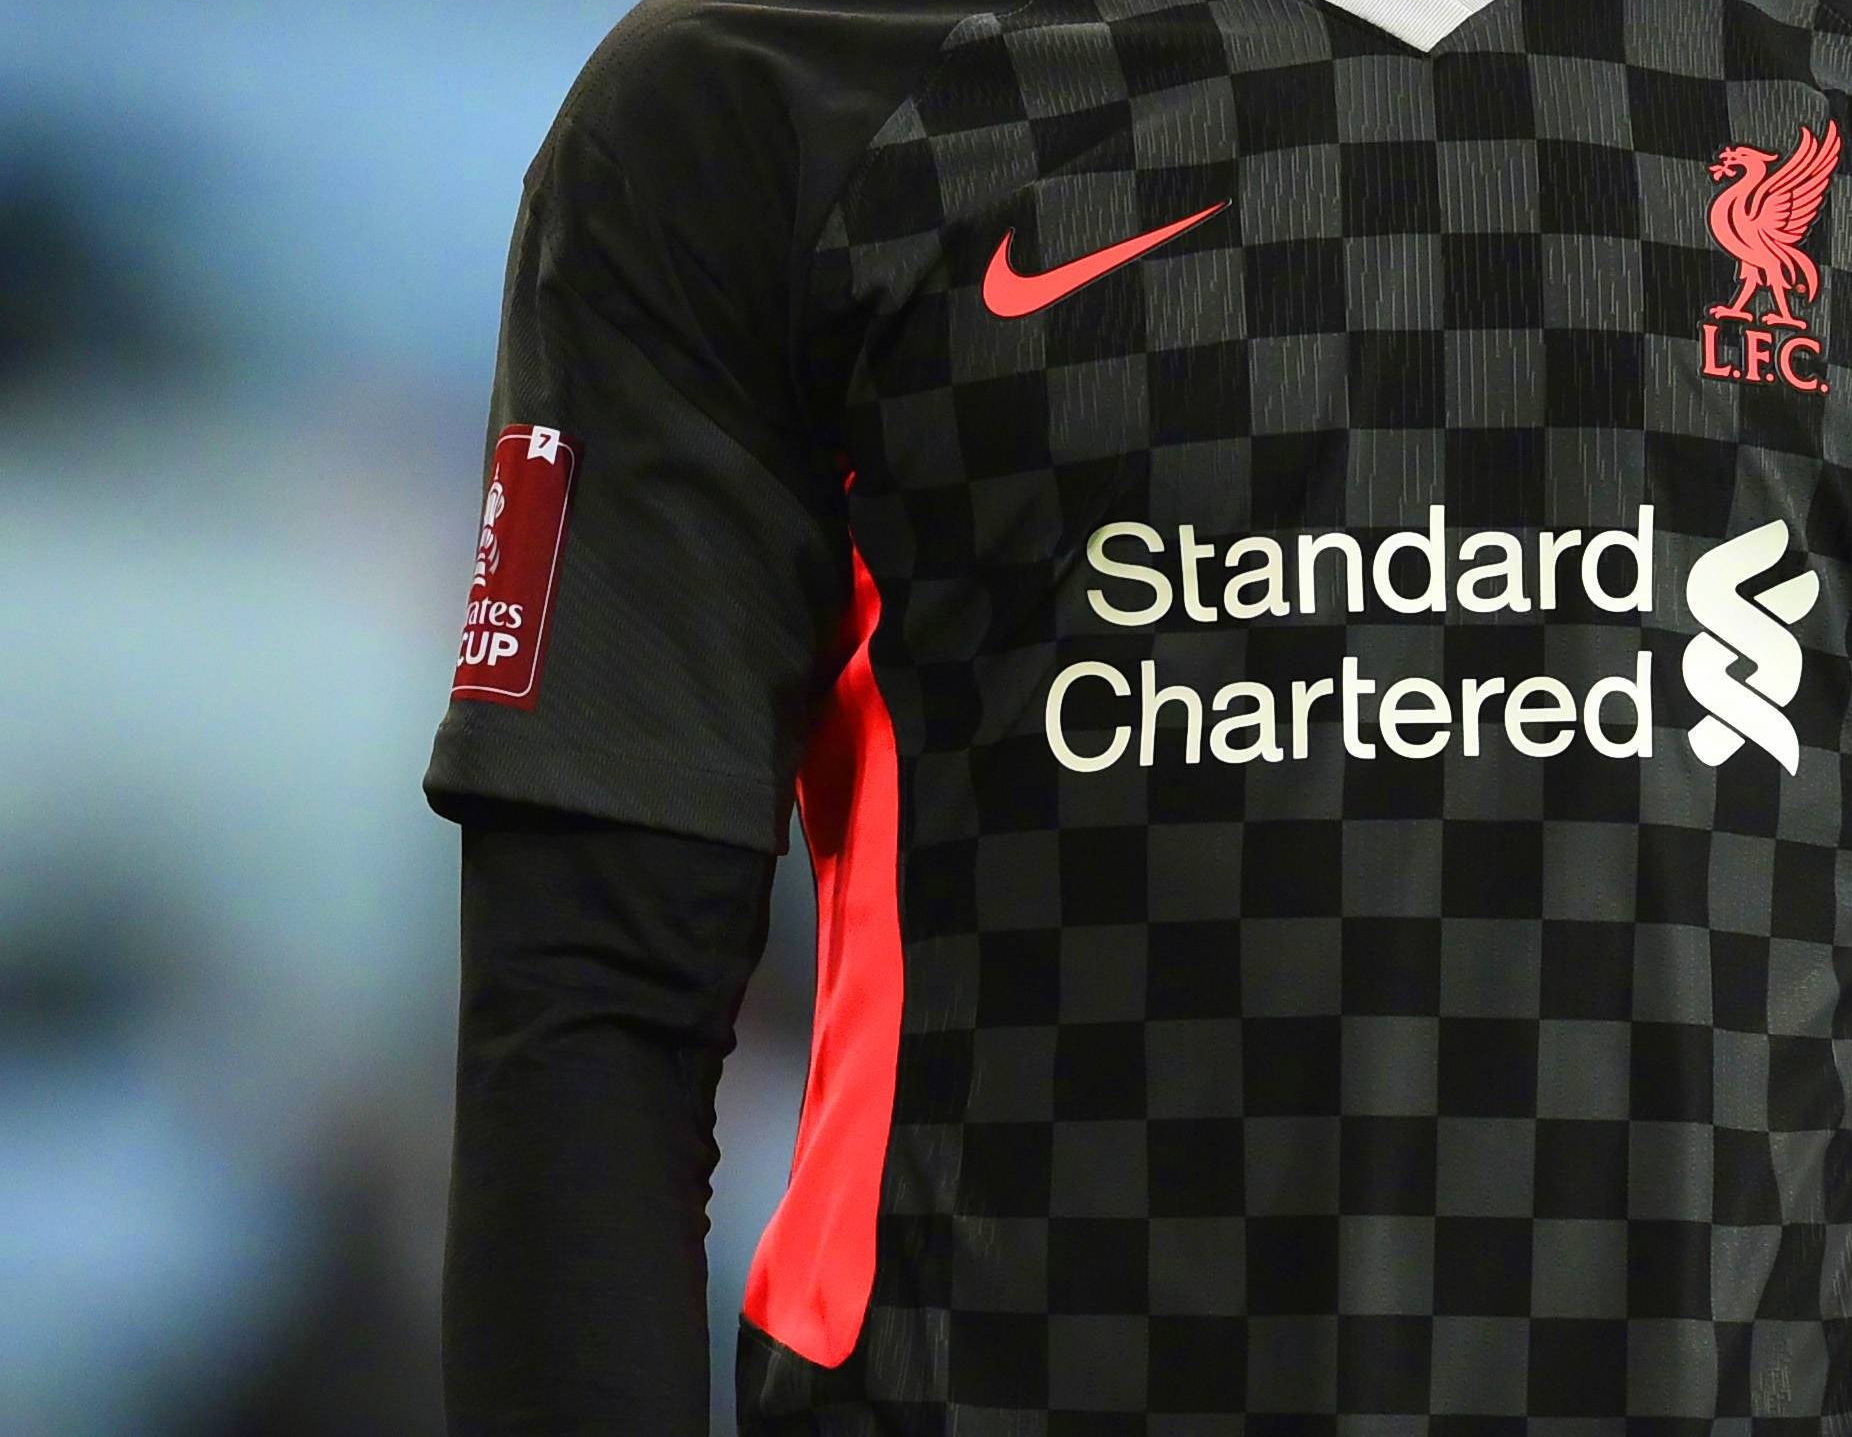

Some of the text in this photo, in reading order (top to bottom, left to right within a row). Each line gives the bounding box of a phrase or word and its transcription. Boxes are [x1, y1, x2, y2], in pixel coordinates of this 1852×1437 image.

[1702, 324, 1829, 393] L.F.C.
[538, 433, 551, 449] 7
[1085, 504, 1655, 627] Standard
[1045, 650, 1654, 773] Chartered
